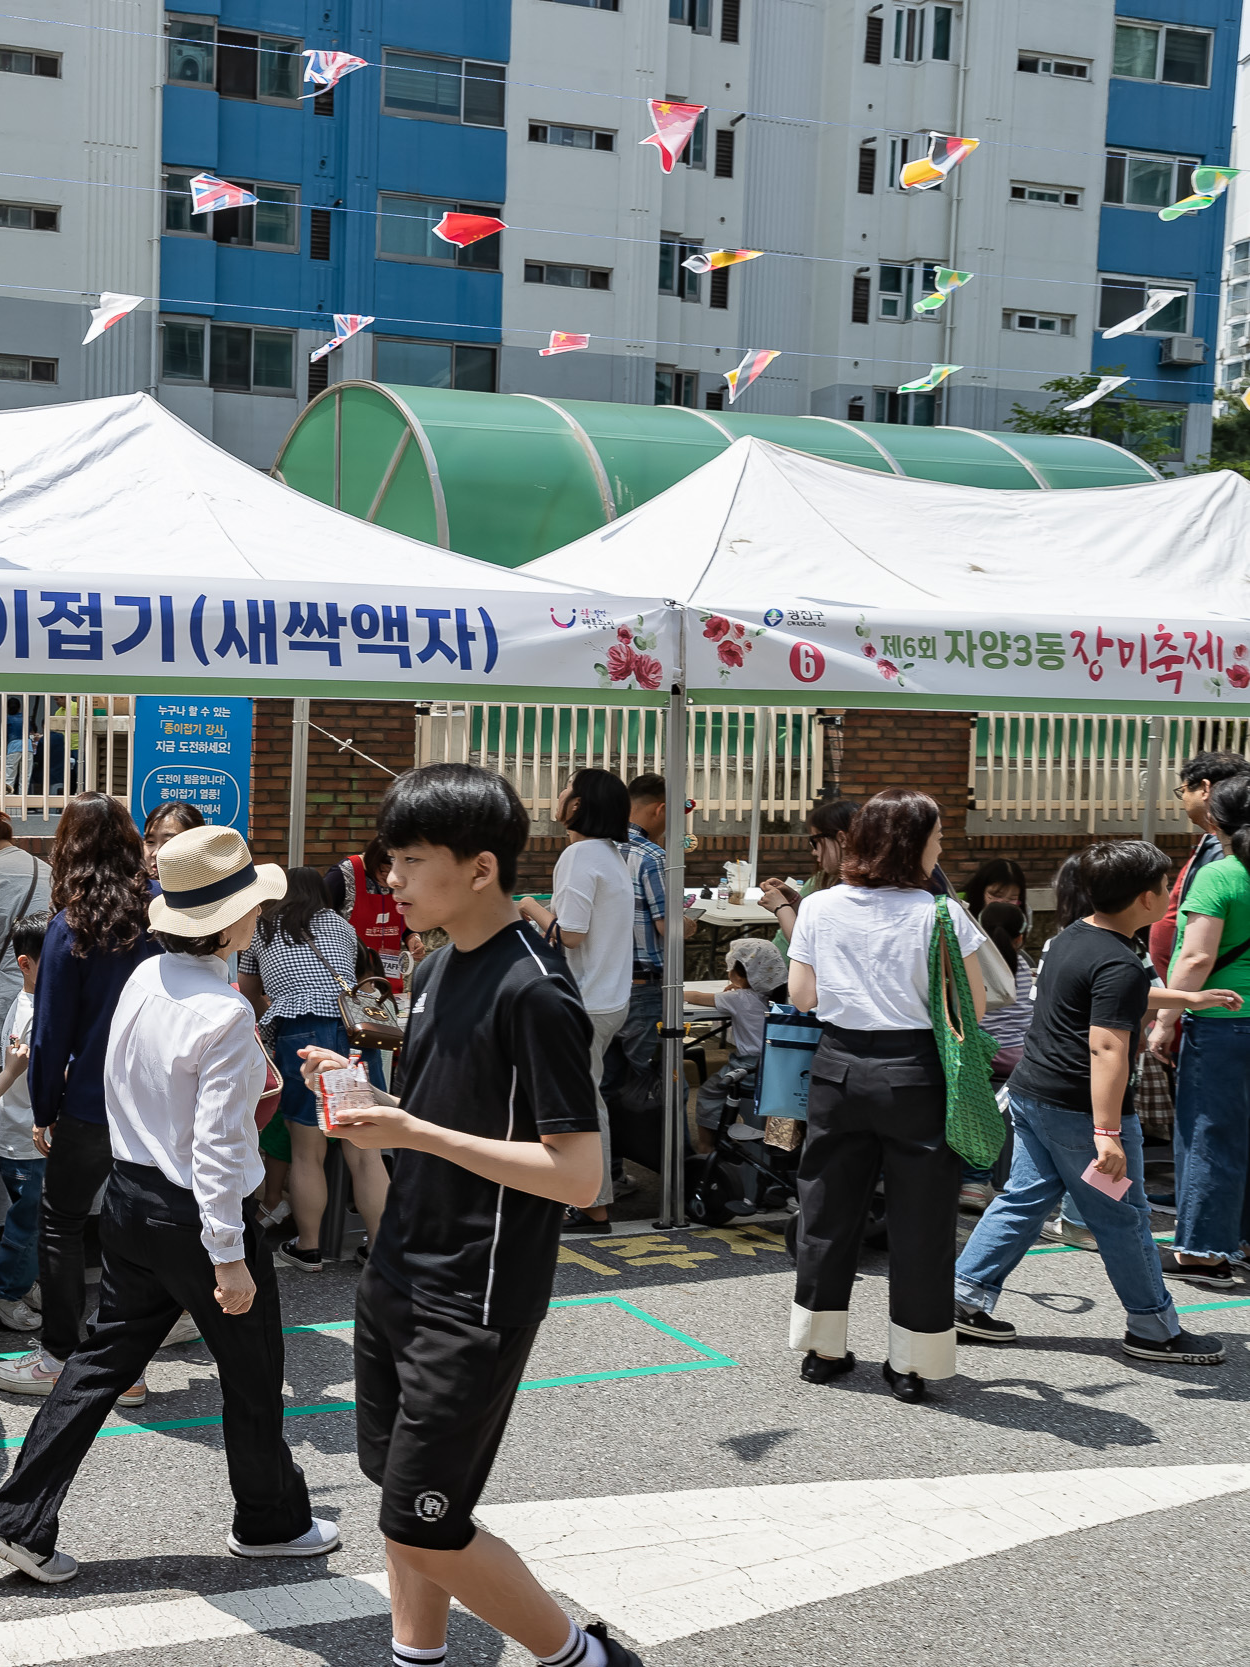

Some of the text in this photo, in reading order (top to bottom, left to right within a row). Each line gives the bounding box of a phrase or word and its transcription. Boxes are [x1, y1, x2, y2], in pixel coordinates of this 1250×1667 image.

[786, 609, 824, 621] 광진구
[800, 644, 816, 679] 6
[881, 623, 1224, 694] 제6회 자양3동 장미축제
[158, 704, 232, 718] 누구나 할 수 있는
[155, 740, 231, 755] 지금 도전하세요!
[156, 774, 226, 786] 도전이 젊음입니다!
[160, 788, 221, 800] 종이접기 열풍!
[1181, 1354, 1221, 1363] crocs
